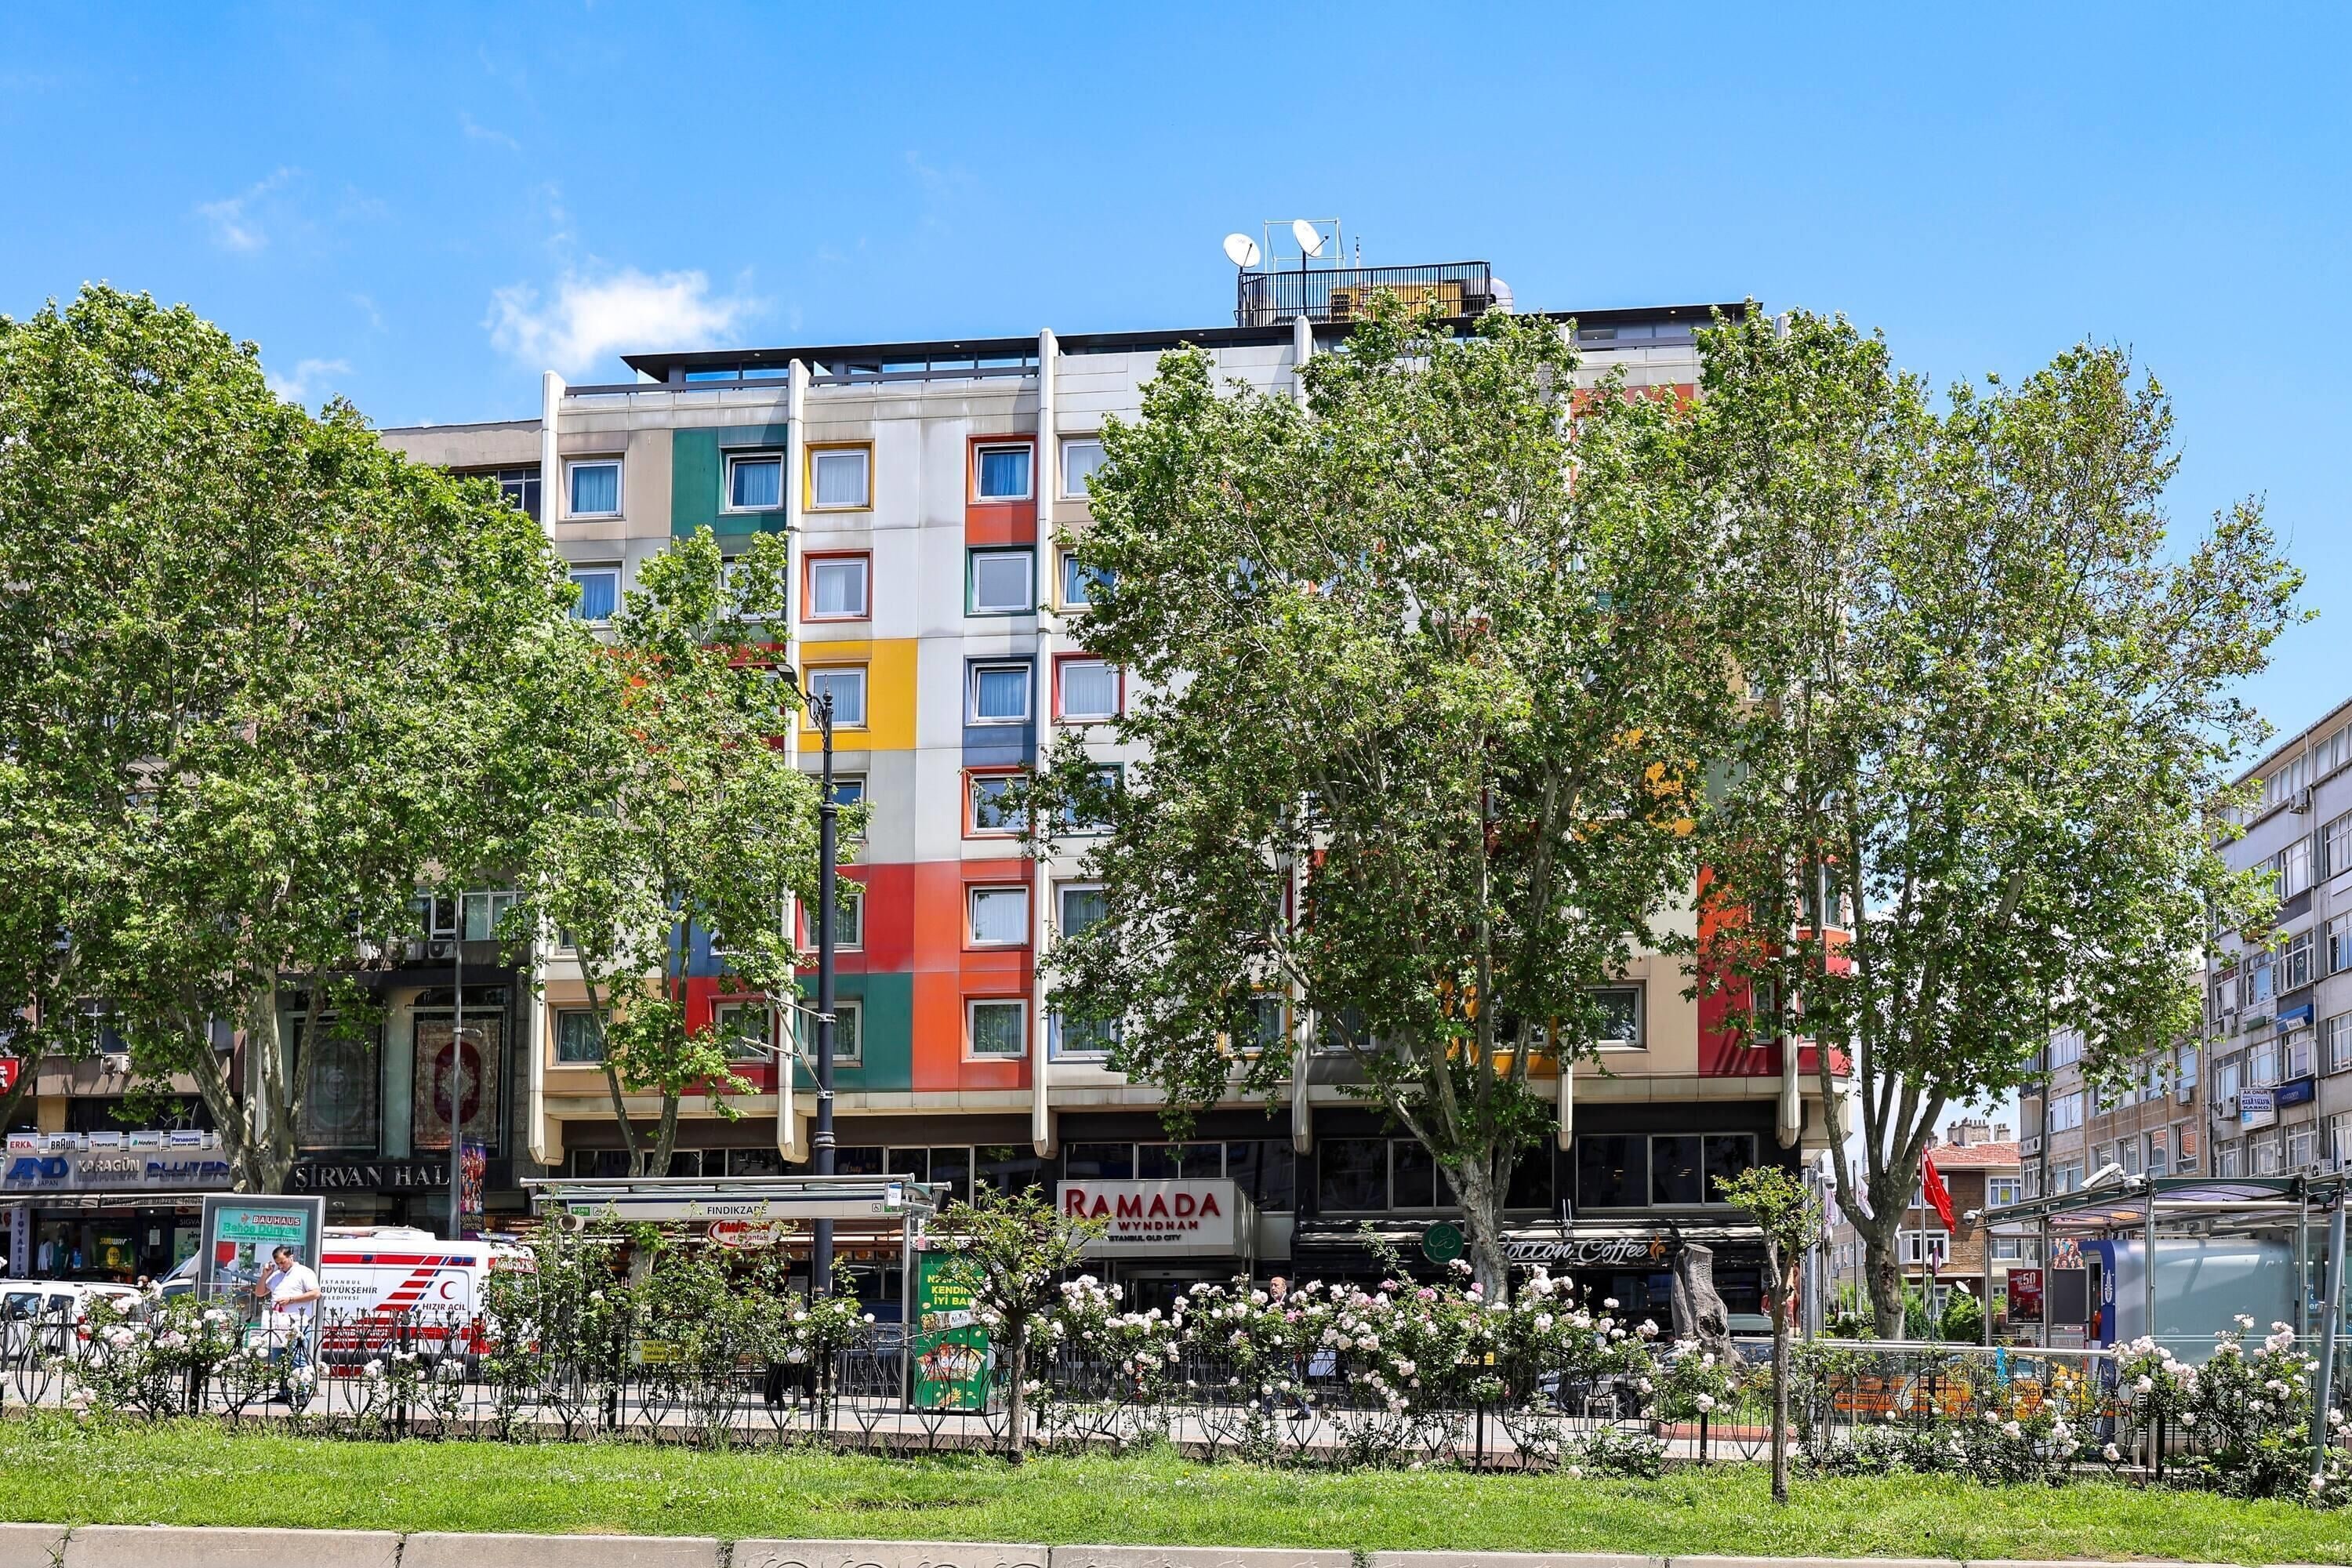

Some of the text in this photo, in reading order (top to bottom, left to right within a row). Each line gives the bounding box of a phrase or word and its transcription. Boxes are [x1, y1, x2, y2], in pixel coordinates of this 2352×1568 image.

[78, 1157, 140, 1173] KARAGÜN
[295, 1164, 383, 1192] ŞİRVAN
[1065, 1189, 1221, 1218] RAMADA
[252, 1215, 300, 1225] BAUHAUS
[1118, 1221, 1199, 1231] WYNDHAM
[223, 1222, 300, 1236] Bahçe Dünyası
[100, 1237, 126, 1246] SUBWAY
[1577, 1237, 1649, 1263] Coffee
[320, 1286, 378, 1294] BÜYÜKŞEHİR
[933, 1294, 949, 1305] İYİ
